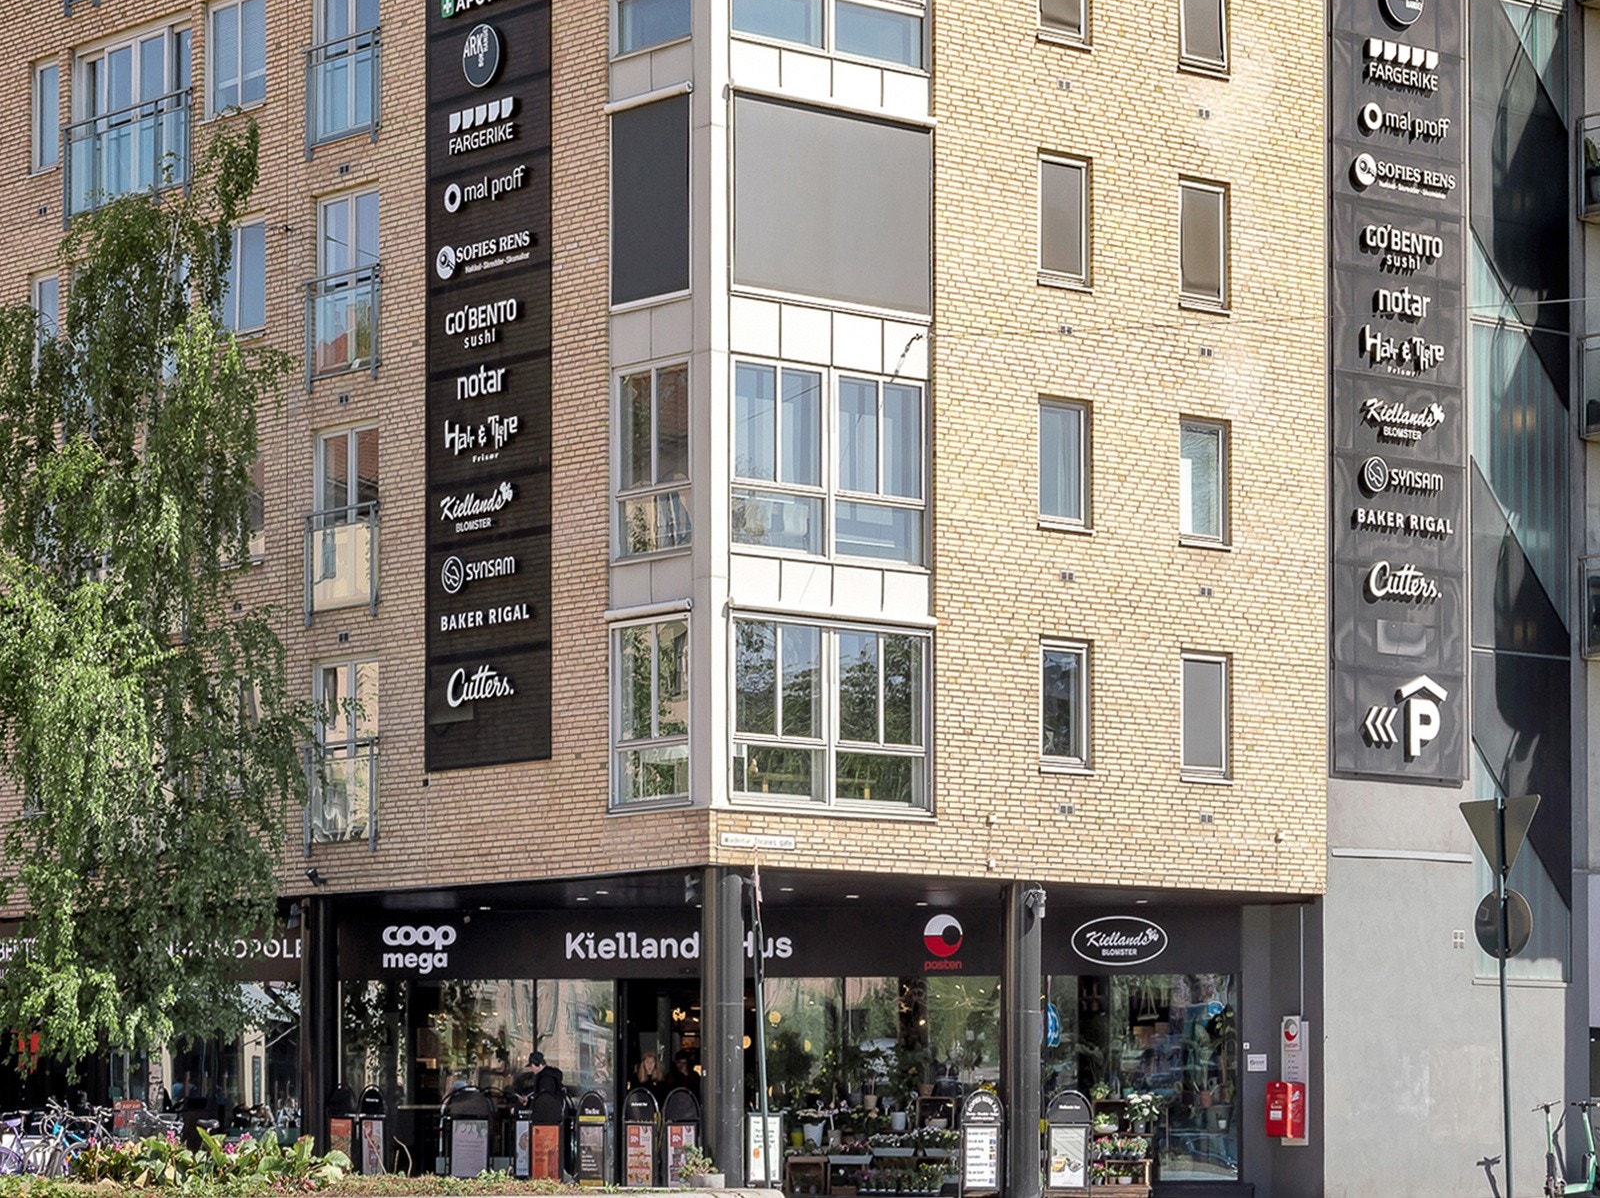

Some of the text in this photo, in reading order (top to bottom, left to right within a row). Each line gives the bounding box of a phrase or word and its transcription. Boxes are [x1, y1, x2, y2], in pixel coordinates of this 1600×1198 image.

[1369, 61, 1439, 91] FARGERIKE
[1385, 111, 1451, 138] mal proff
[449, 122, 514, 156] FARGERIKE
[464, 164, 525, 202] mal proff
[1377, 160, 1421, 184] SOFIES
[1423, 170, 1456, 191] RENS
[456, 230, 530, 263] SOFIES RENS
[1386, 253, 1422, 270] sushi
[1379, 286, 1431, 318] notar
[463, 327, 496, 349] sushi
[457, 364, 506, 400] notar
[1383, 425, 1422, 440] BLOMSTER
[1391, 468, 1444, 492] SYNSAM
[440, 489, 505, 521] Kiellands
[455, 517, 492, 533] BLOMSTER
[1357, 507, 1454, 534] BAKER RIGAL
[465, 556, 516, 581] SYNSAM
[440, 603, 530, 632] BAKER RIGAL
[1410, 698, 1441, 756] P
[382, 925, 457, 951] coop
[565, 931, 700, 960] Kielland
[1086, 931, 1149, 947] Kiellands
[382, 952, 448, 975] mega
[923, 959, 963, 972] posten
[1101, 948, 1138, 957] BLOMSTER
